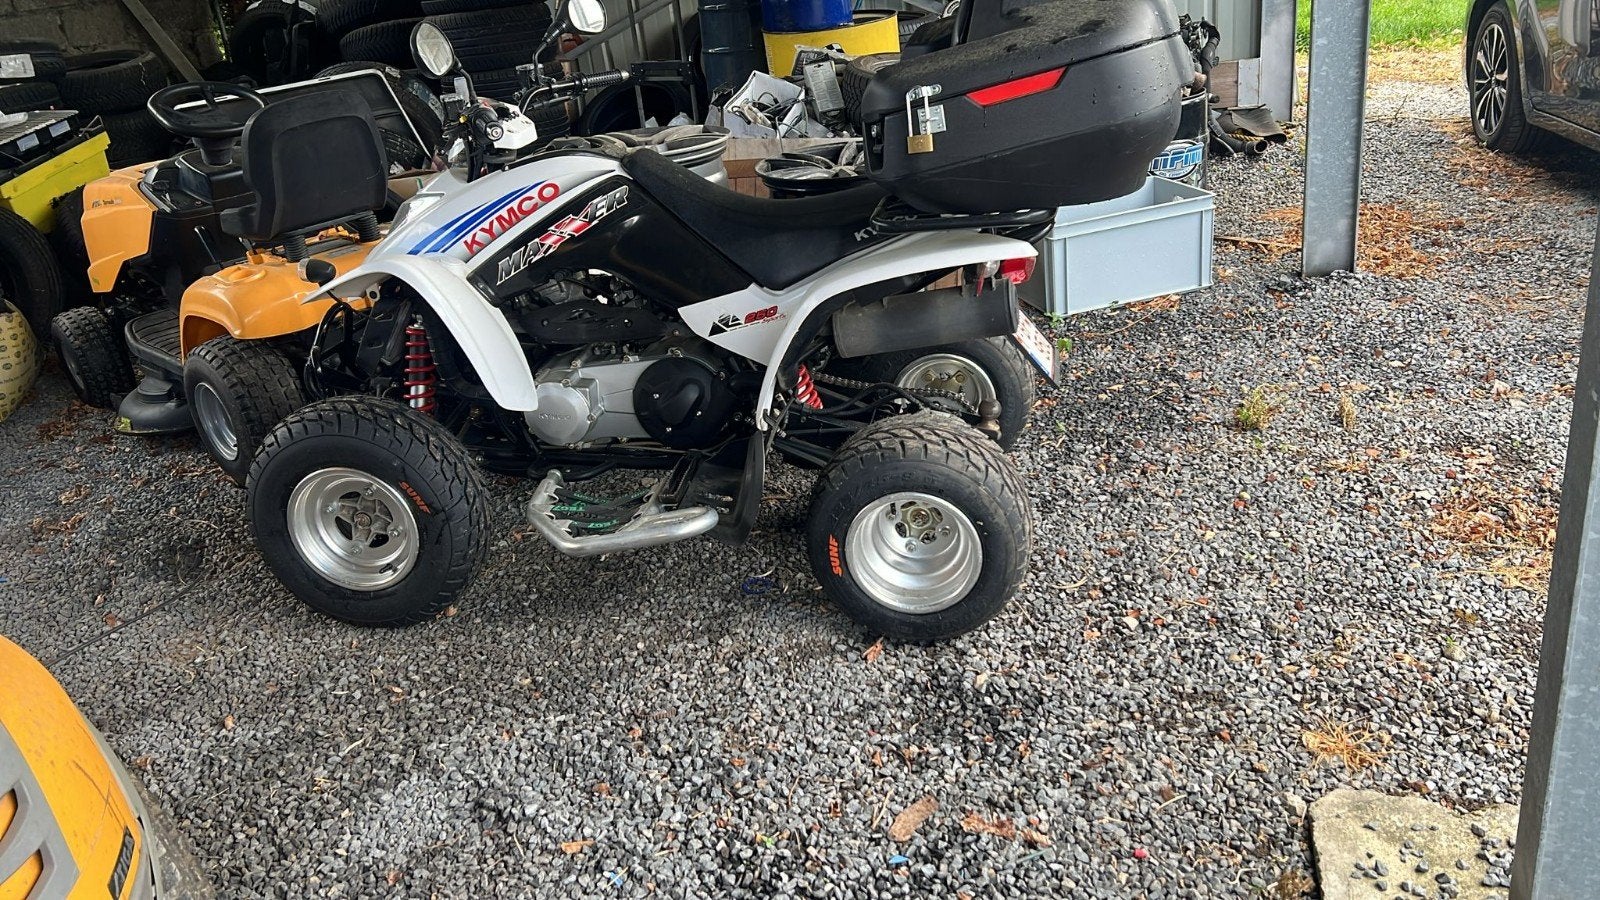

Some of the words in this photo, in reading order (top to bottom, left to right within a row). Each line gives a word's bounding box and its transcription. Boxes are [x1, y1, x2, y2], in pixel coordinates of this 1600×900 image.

[464, 182, 560, 254] KYMCO
[496, 185, 629, 285] MAXXER
[744, 305, 779, 325] 250
[399, 481, 431, 514] SUNF
[829, 534, 842, 577] SUNF
